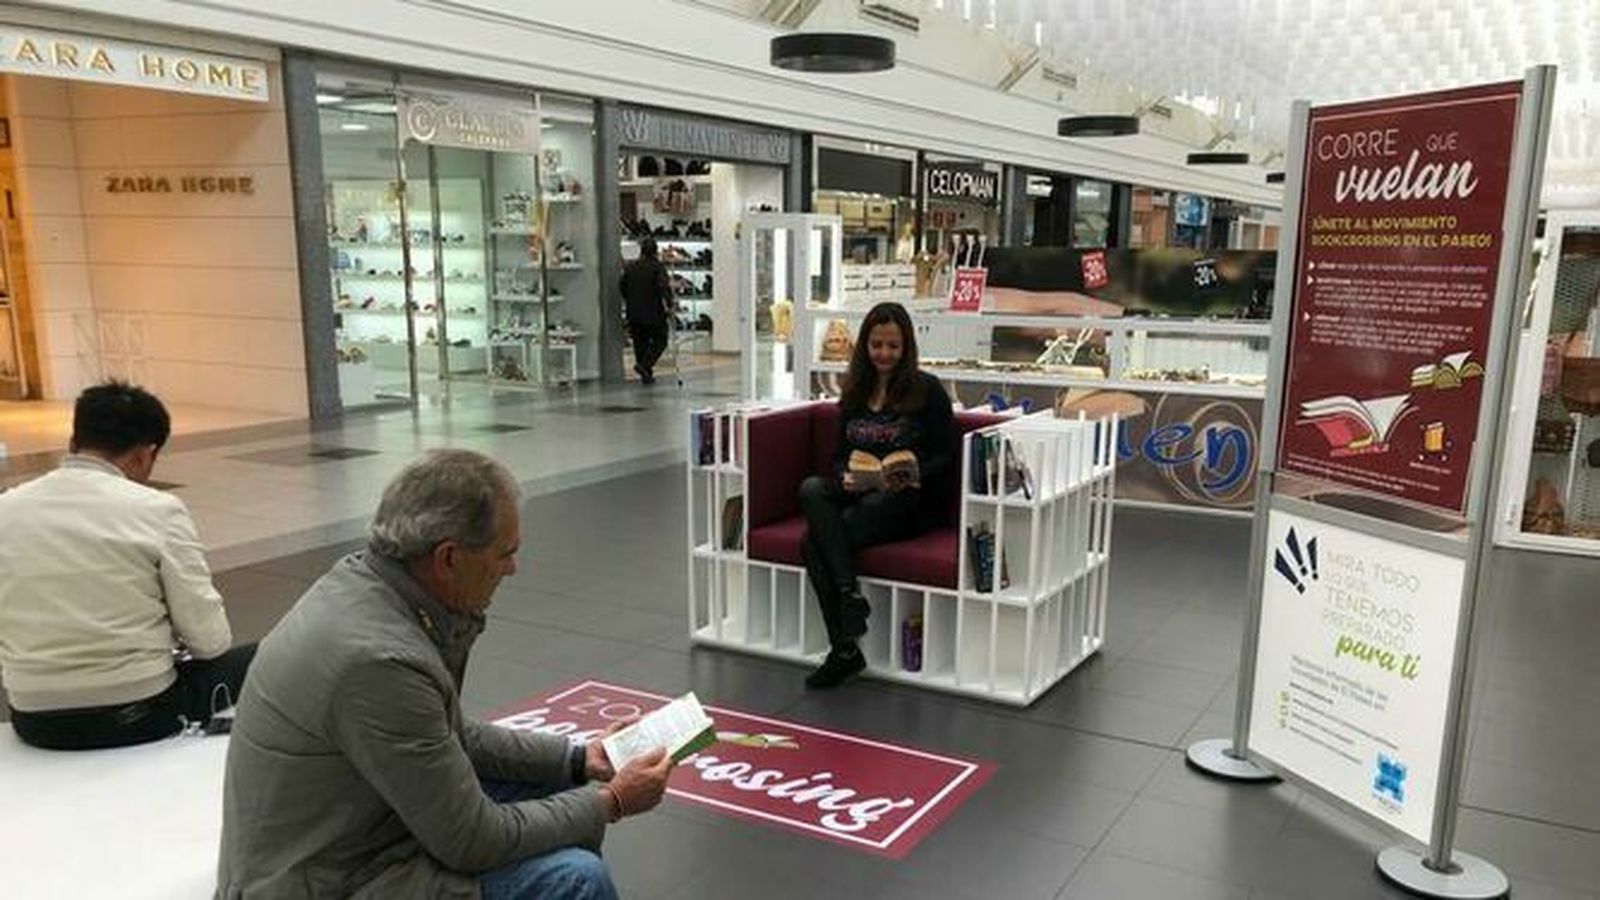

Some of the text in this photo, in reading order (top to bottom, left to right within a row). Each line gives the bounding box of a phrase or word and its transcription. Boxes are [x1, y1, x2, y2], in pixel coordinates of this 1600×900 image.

[139, 53, 261, 94] HOME
[1317, 128, 1459, 161] CORRE QUE
[105, 175, 172, 194] ZARA
[1335, 150, 1478, 203] vuelan
[1371, 215, 1457, 230] MOVIMIENTO
[1372, 562, 1422, 593] TODO
[1325, 585, 1417, 635] TENEMOS
[1335, 634, 1422, 680] para ti
